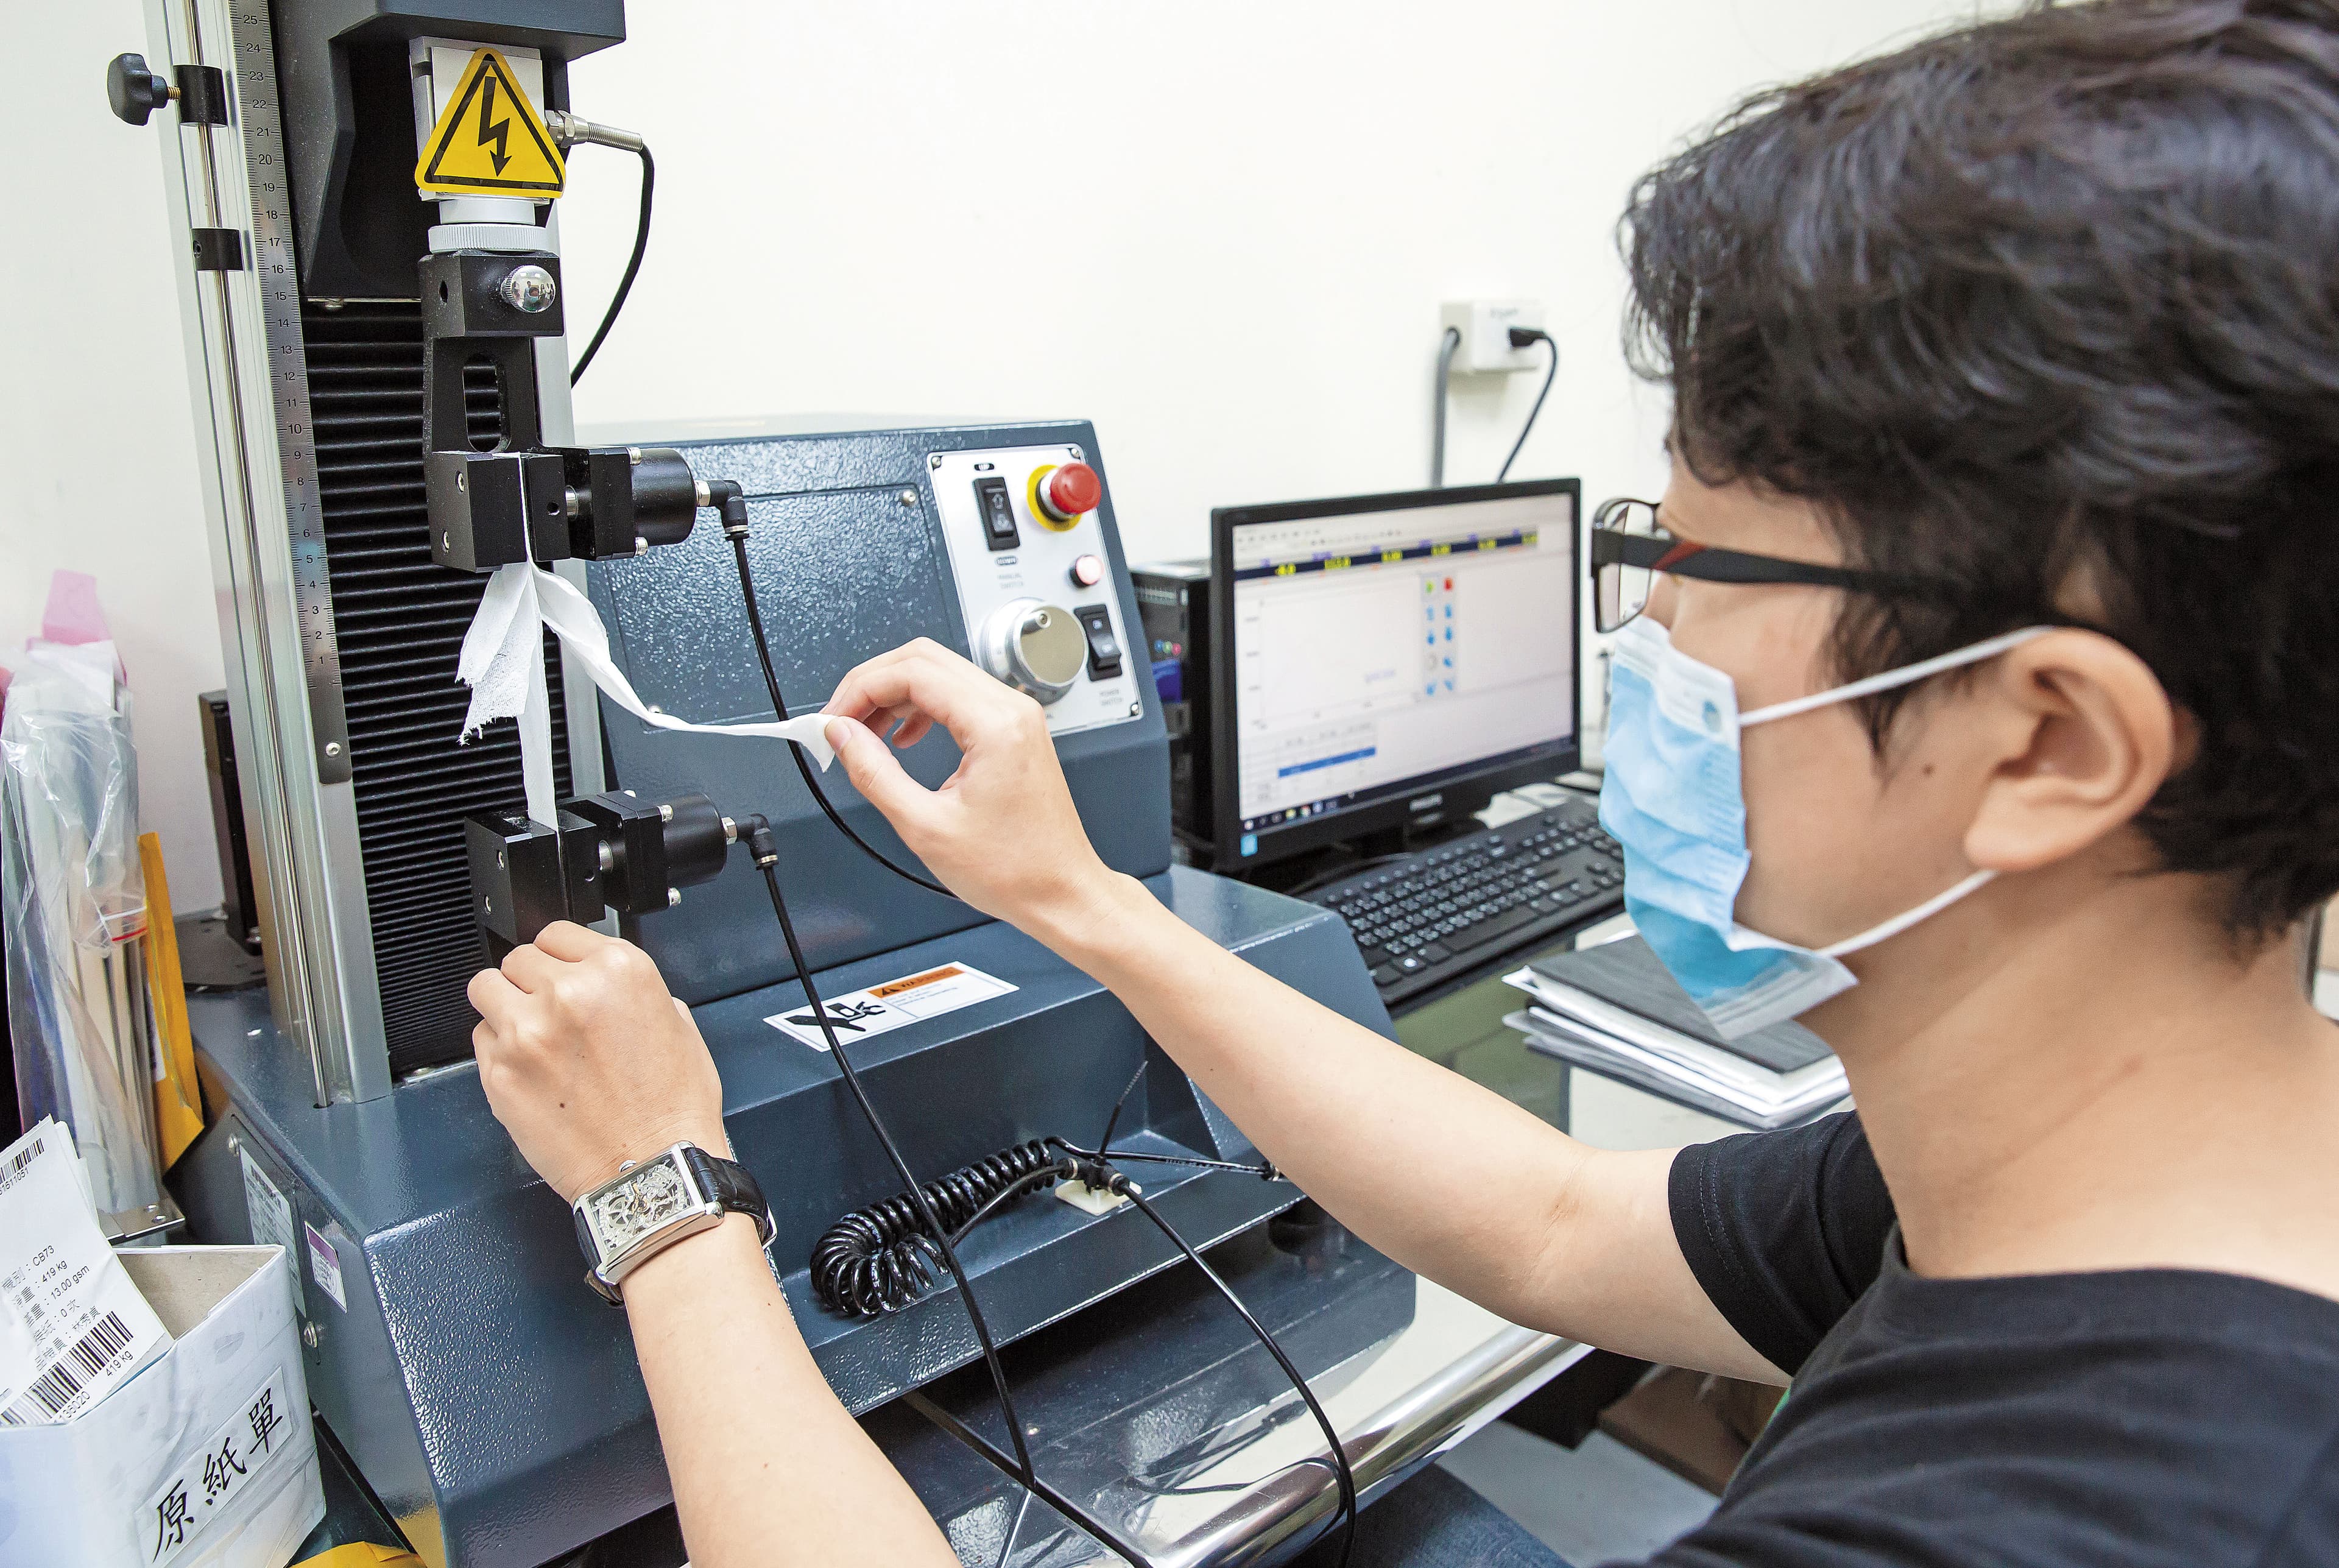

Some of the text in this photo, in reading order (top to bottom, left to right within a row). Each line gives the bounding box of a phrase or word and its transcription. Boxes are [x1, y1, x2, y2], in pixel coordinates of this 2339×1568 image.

[244, 16, 258, 25] 25
[247, 44, 261, 53] 24
[250, 72, 264, 81] 23
[253, 100, 267, 108] 22
[256, 128, 269, 136] 21
[259, 155, 272, 165] 20
[263, 183, 275, 192] 19
[266, 210, 278, 219] 18
[269, 238, 281, 246] 17
[272, 265, 284, 274] 16
[275, 292, 286, 300] 15
[278, 319, 289, 327] 14
[283, 372, 295, 381] 12
[289, 424, 302, 434] 10
[294, 451, 302, 460] 9
[297, 478, 304, 486] 8
[306, 555, 313, 563] 5
[33, 1245, 54, 1266] CB73
[42, 1268, 56, 1282] 419
[55, 1260, 67, 1270] kg
[51, 1279, 72, 1299] 13.00
[72, 1266, 90, 1284] gsm
[106, 1351, 133, 1376] 419 kg
[54, 1391, 90, 1424] 136020
[152, 1387, 283, 1563] 原紙單
